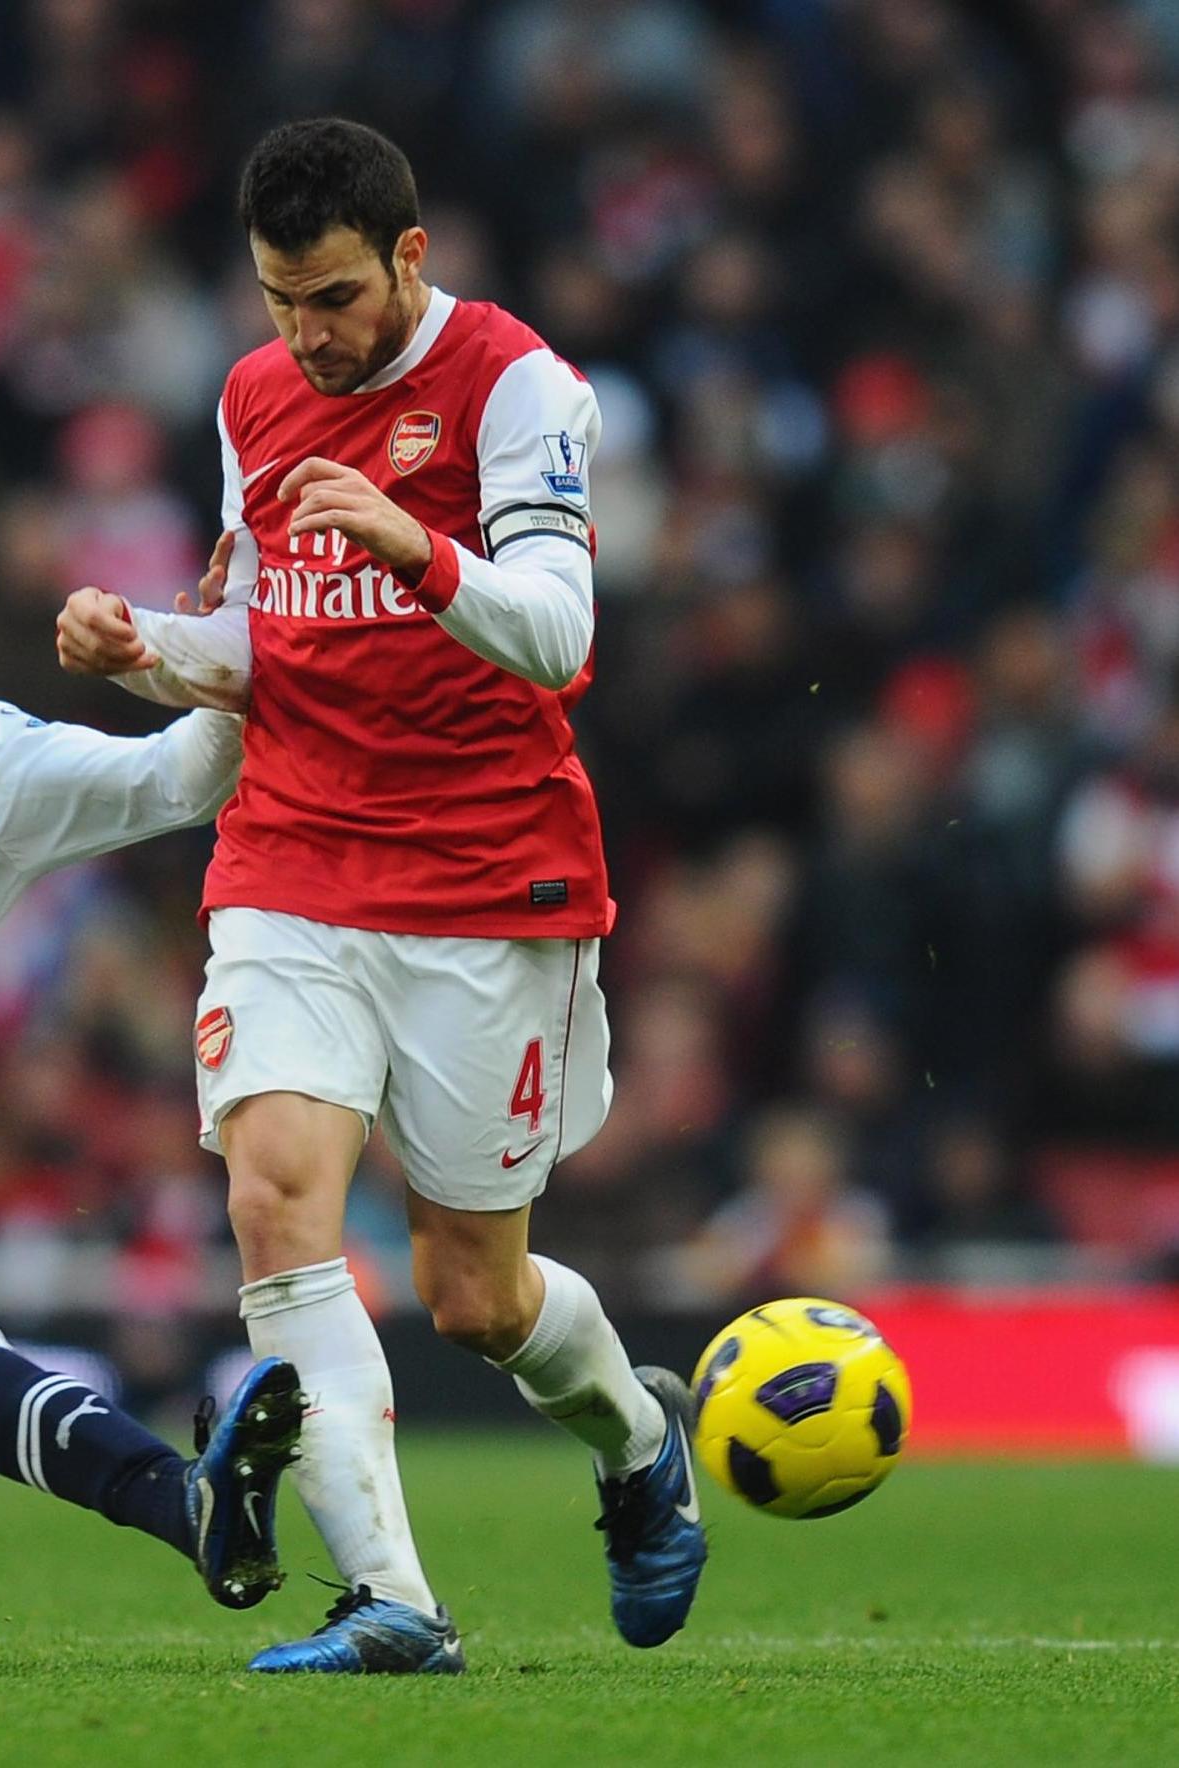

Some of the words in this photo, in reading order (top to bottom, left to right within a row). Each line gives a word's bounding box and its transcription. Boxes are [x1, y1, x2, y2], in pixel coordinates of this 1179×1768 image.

[399, 422, 433, 435] Arsenal
[248, 560, 427, 619] mirate
[507, 1035, 548, 1136] 4
